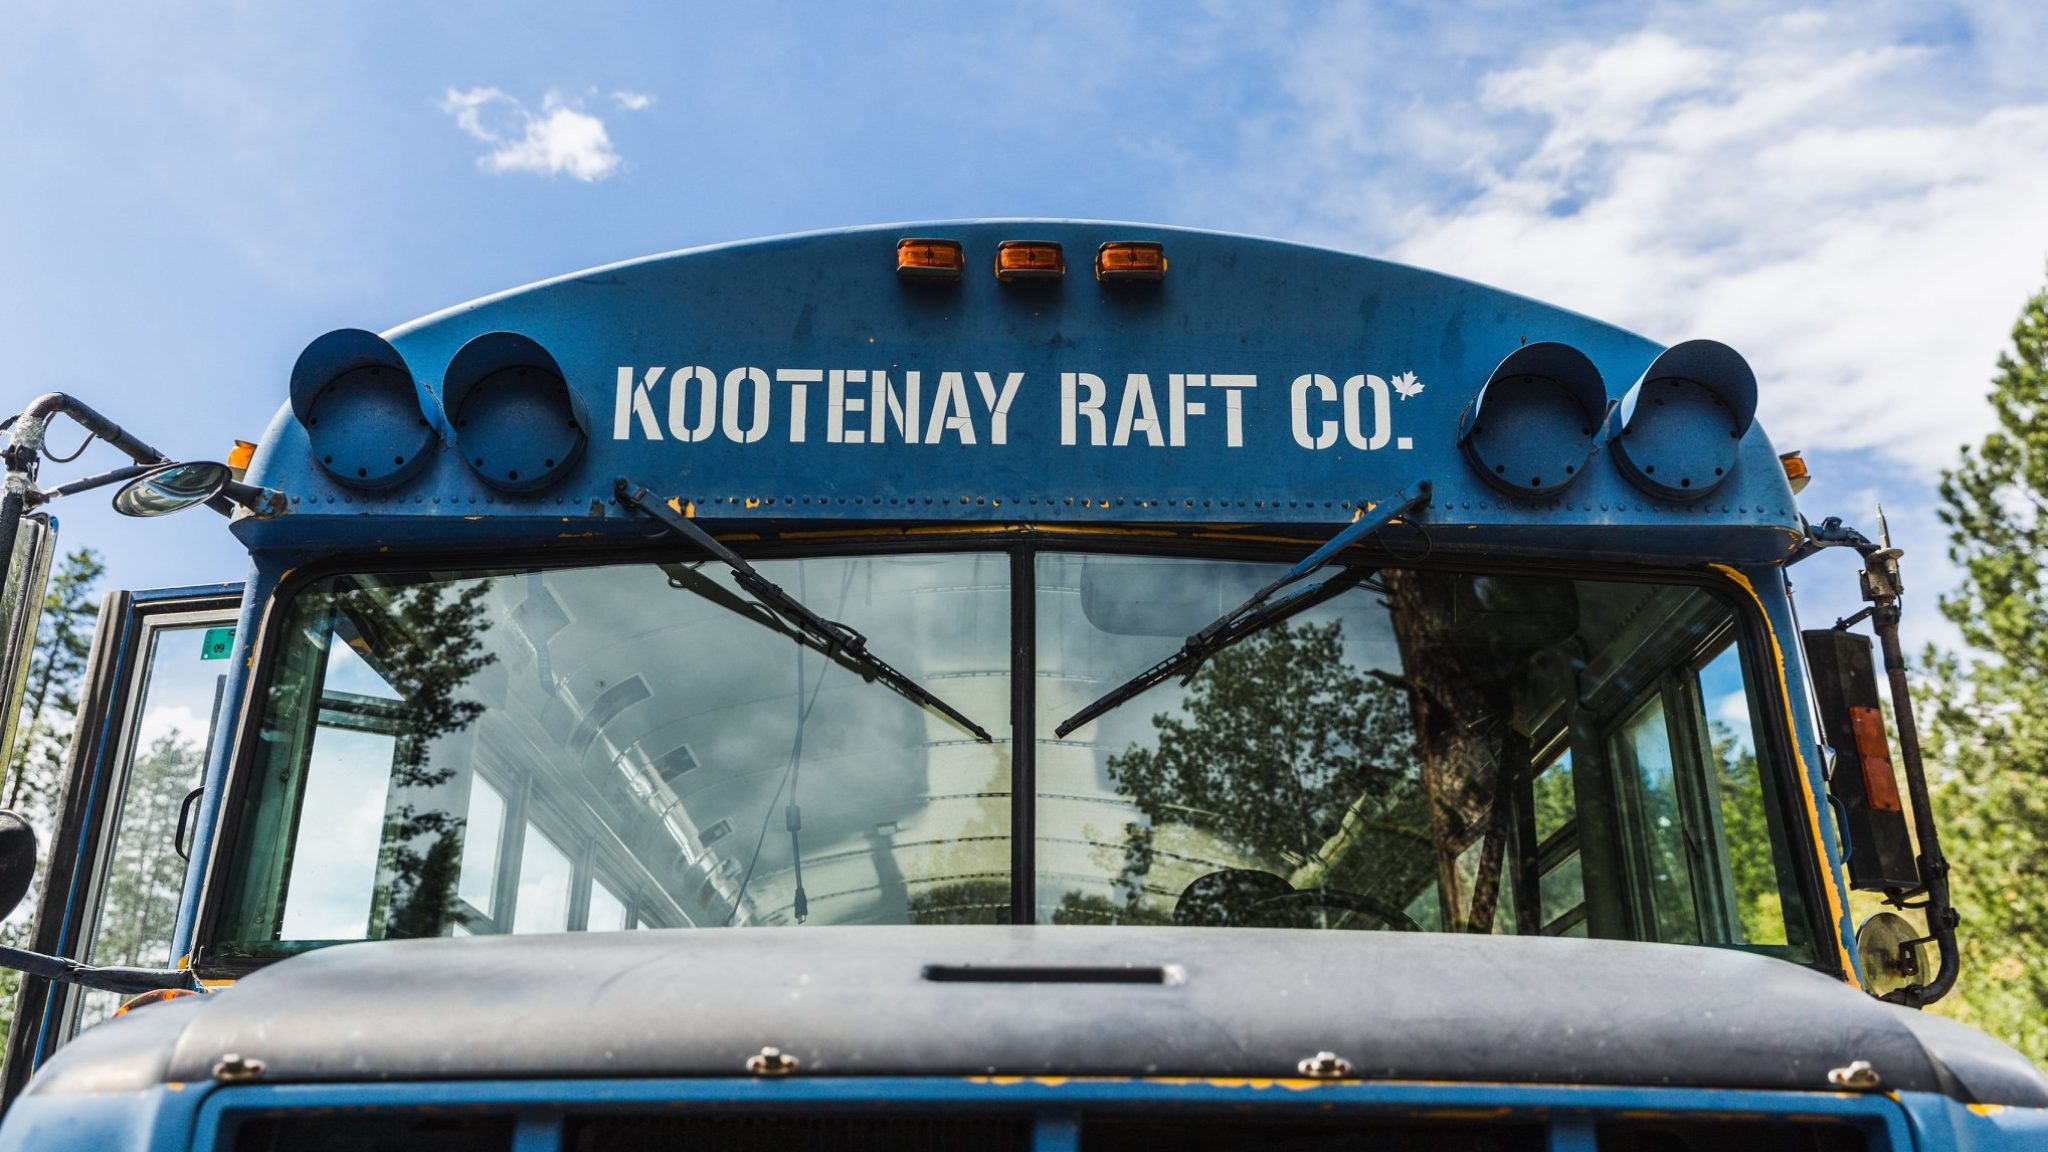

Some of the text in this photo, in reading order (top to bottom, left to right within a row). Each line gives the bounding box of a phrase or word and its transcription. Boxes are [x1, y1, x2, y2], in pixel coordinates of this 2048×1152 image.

[613, 366, 1414, 451] KOOTENAY RAFT CO.
